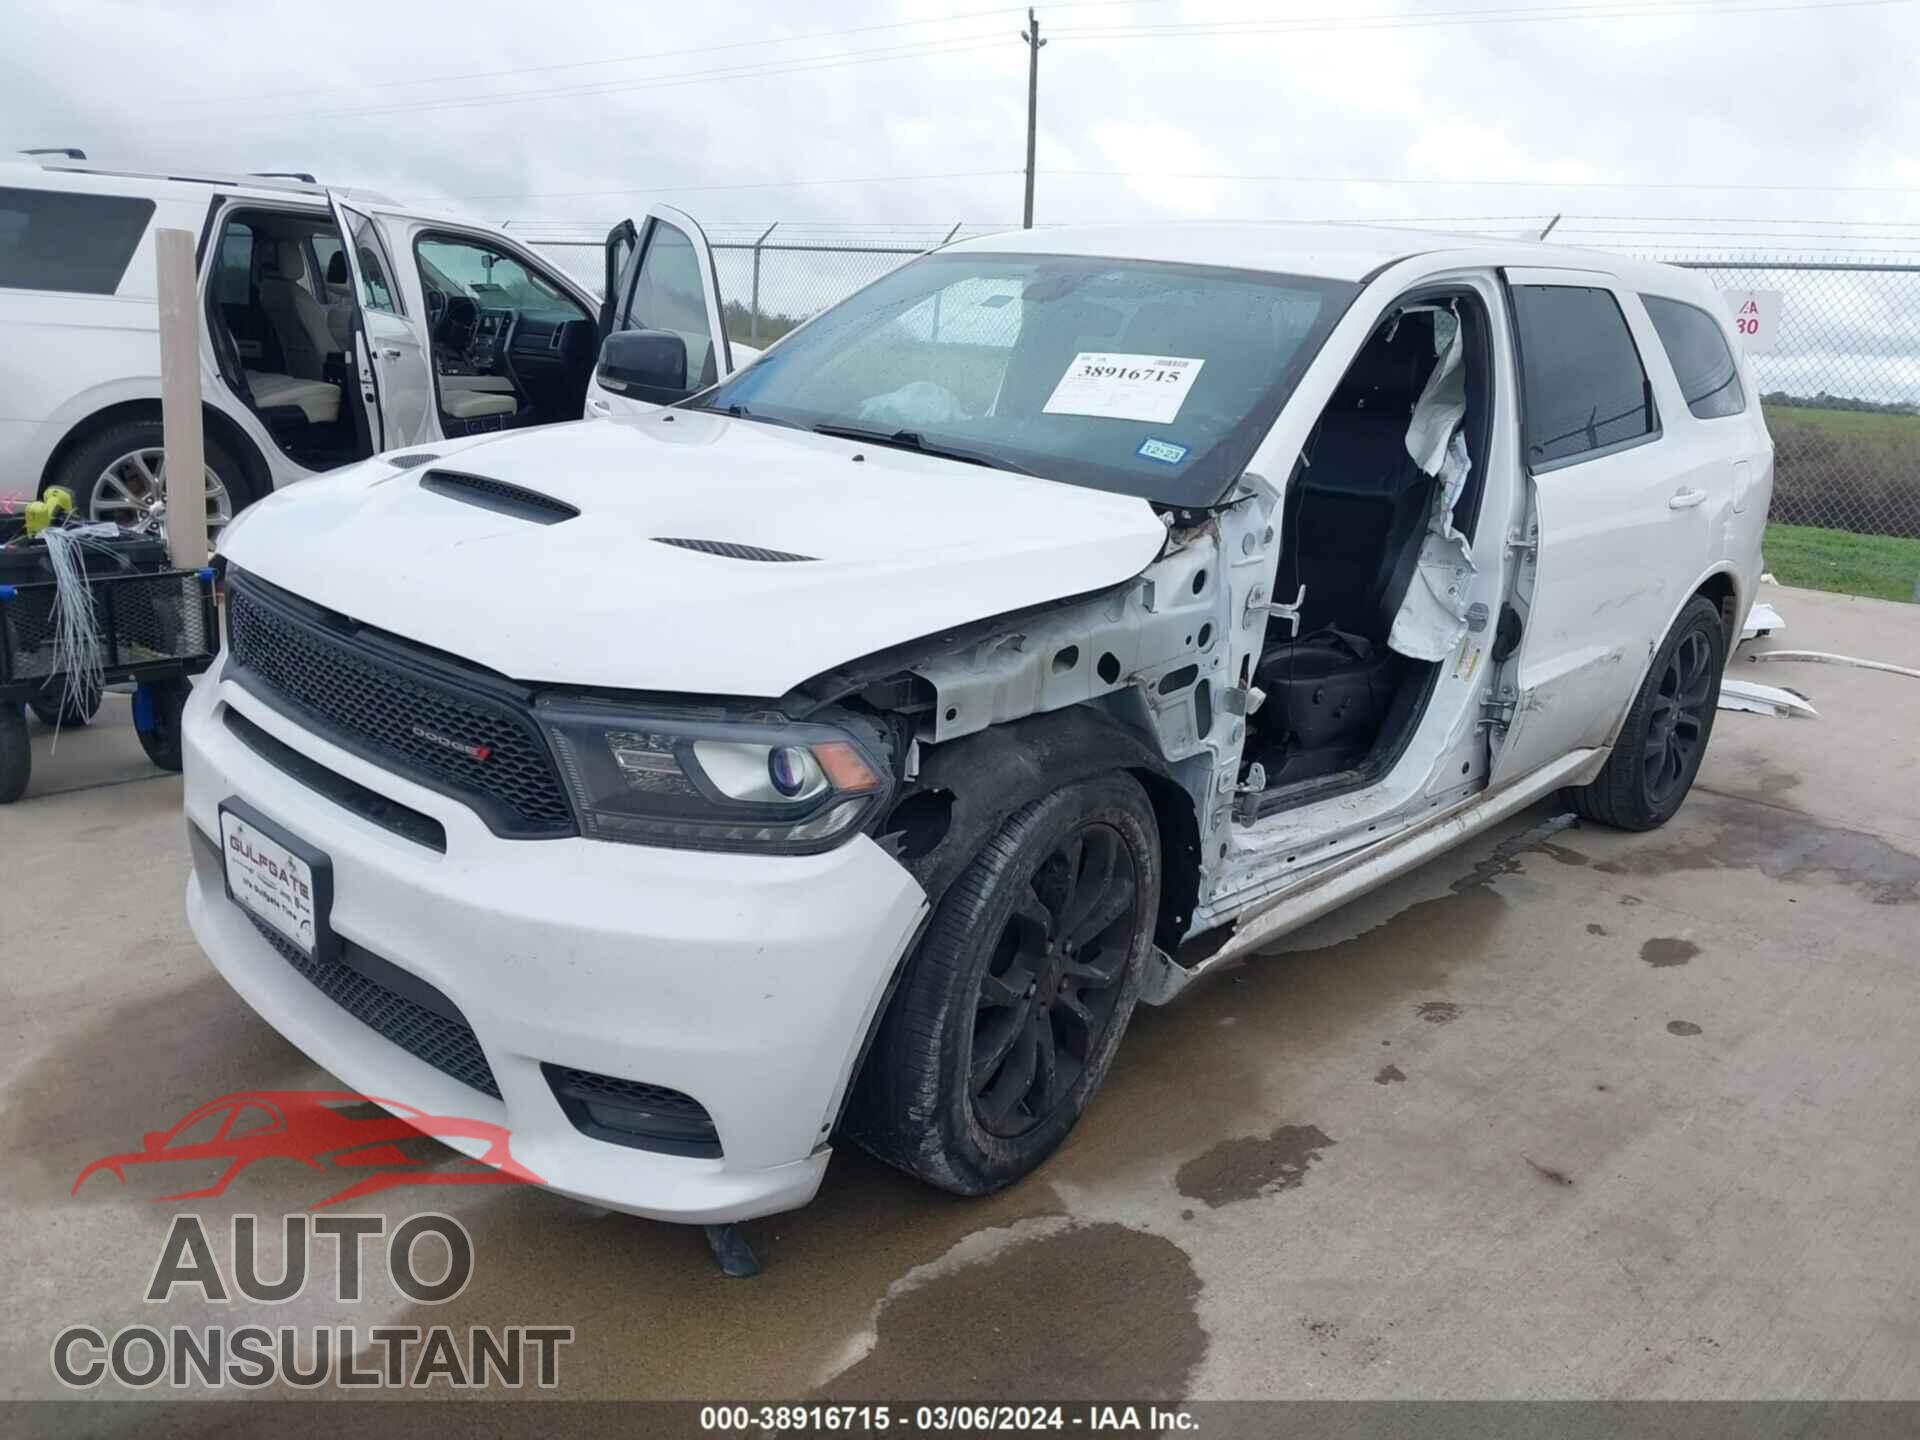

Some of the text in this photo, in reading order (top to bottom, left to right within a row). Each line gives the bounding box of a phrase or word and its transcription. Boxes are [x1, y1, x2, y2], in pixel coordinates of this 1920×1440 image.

[1077, 365, 1182, 383] 38916715
[412, 727, 479, 757] DODGE
[230, 834, 310, 900] GULFGATE
